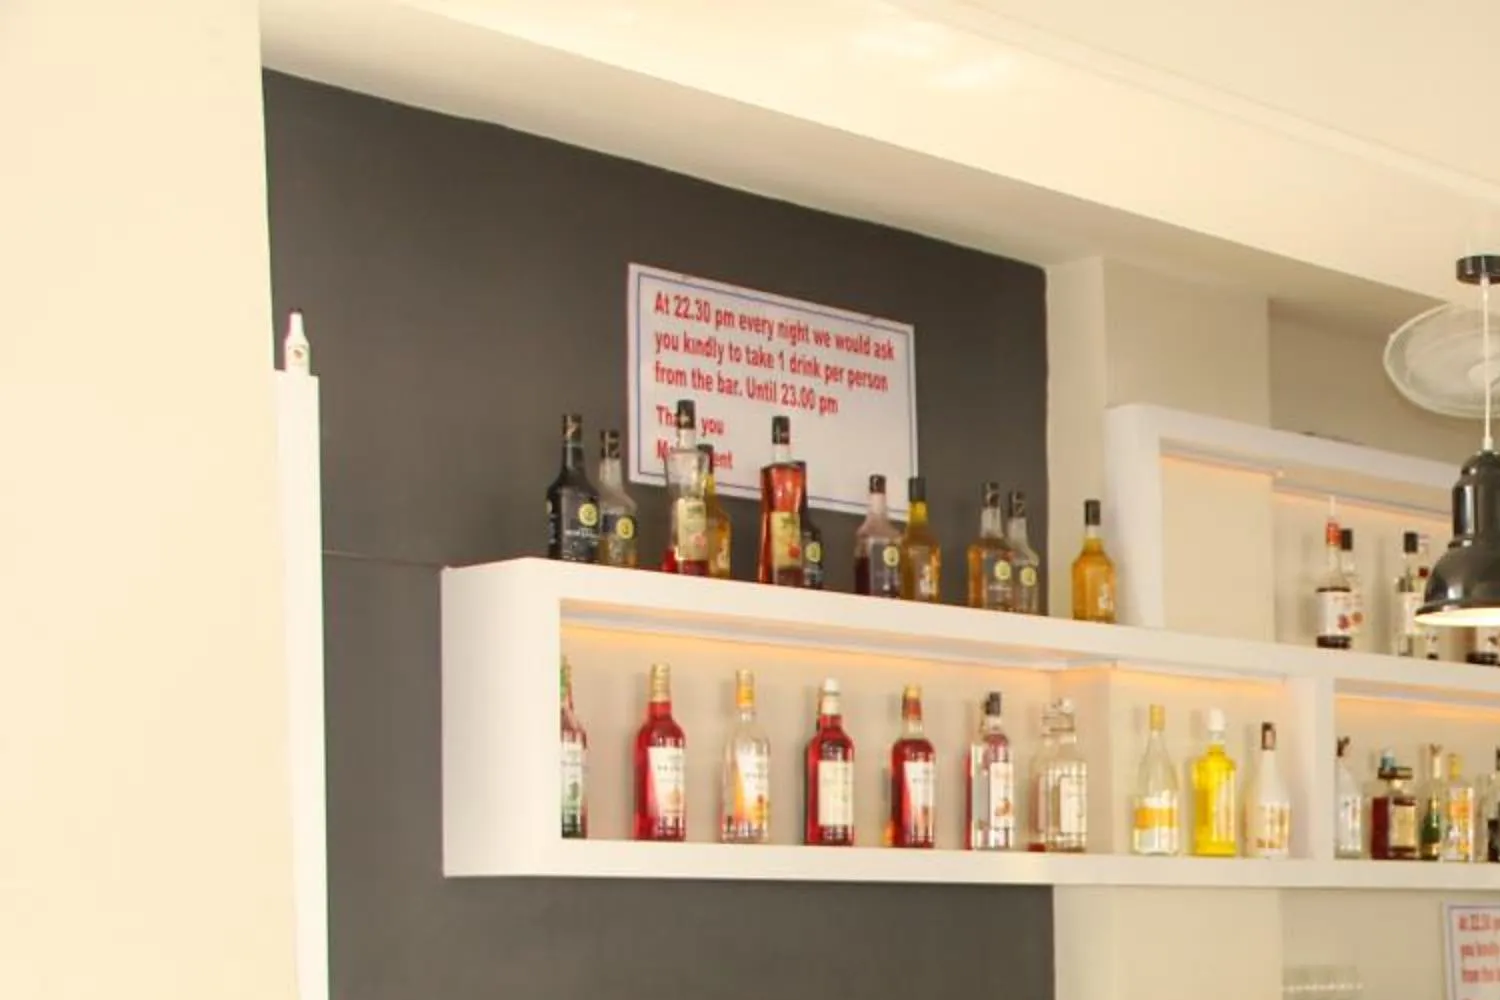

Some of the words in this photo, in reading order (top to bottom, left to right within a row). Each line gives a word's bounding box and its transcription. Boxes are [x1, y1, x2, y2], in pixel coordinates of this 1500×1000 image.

[655, 290, 669, 316] At
[674, 295, 710, 323] 22.30
[716, 309, 734, 331] pm
[739, 314, 774, 341] every
[835, 334, 870, 357] would
[874, 338, 894, 360] ask
[655, 332, 679, 354] you
[684, 330, 724, 365] kindly
[728, 343, 741, 363] to
[745, 345, 774, 369] take
[790, 354, 820, 377] drink
[824, 364, 844, 385] per
[847, 368, 888, 392] person
[655, 361, 687, 387] from
[691, 367, 713, 392] the
[746, 376, 776, 403] Until
[819, 395, 839, 417] pm
[702, 417, 724, 437] you
